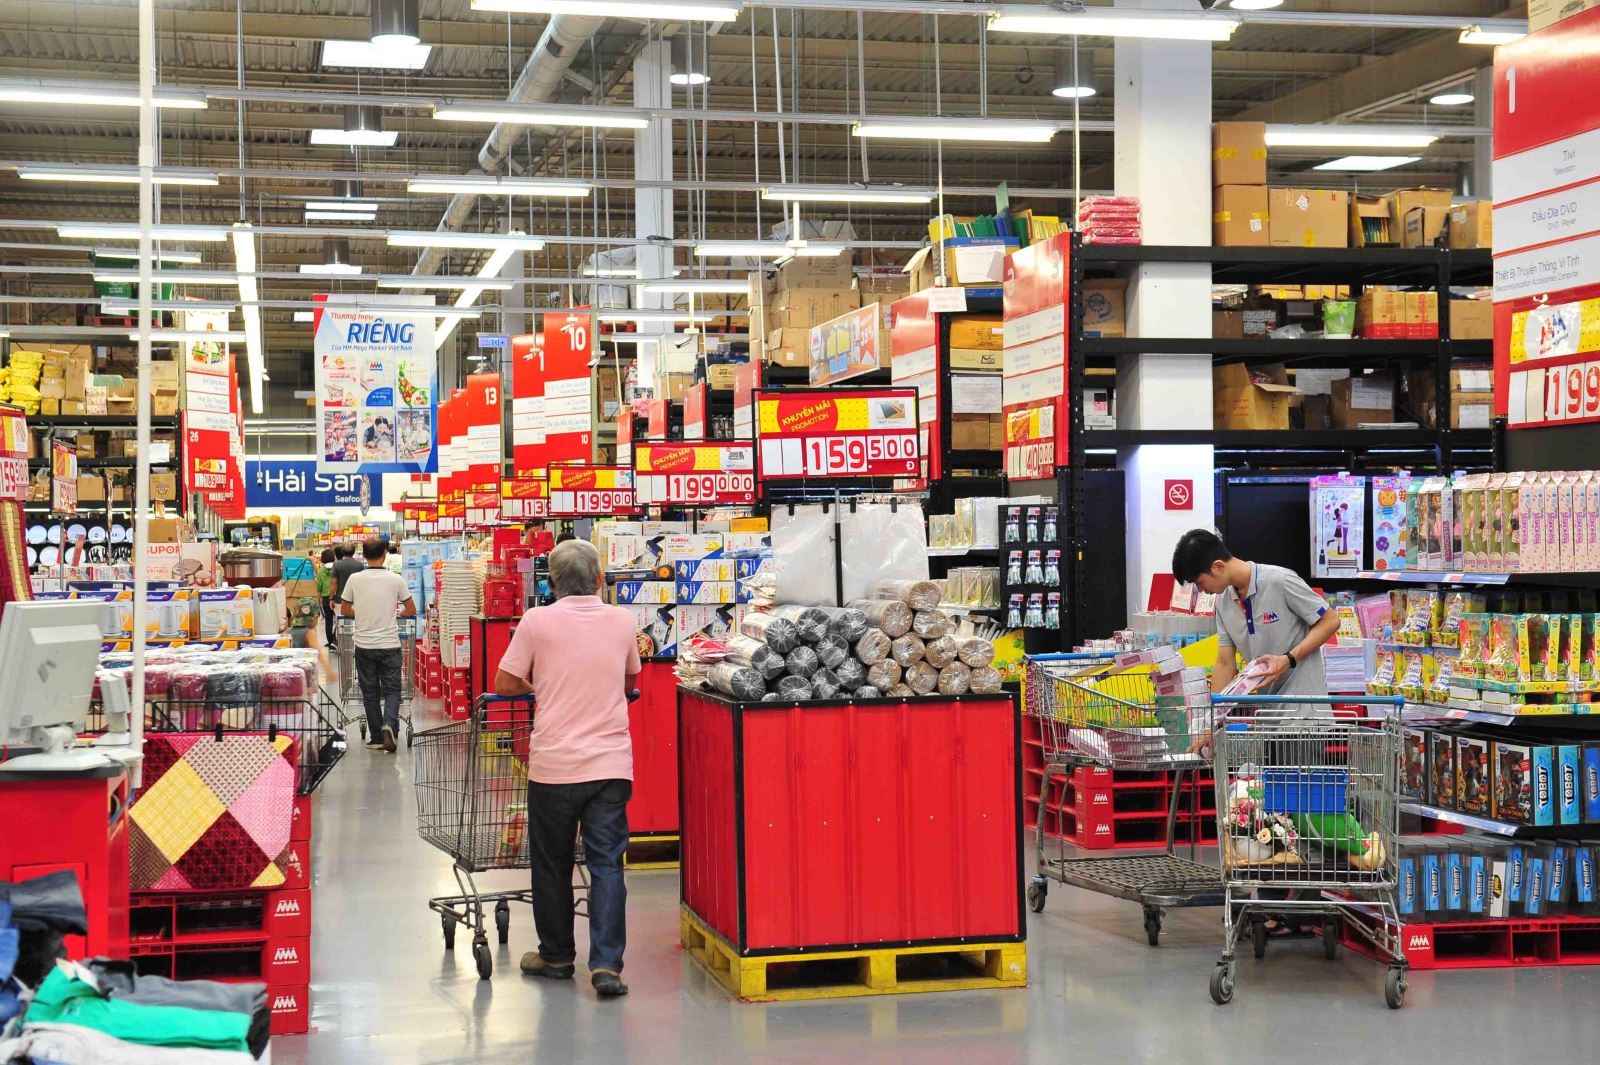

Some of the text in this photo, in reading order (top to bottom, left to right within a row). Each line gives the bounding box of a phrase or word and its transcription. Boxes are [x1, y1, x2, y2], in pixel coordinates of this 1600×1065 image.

[347, 318, 414, 344] RIÊNG
[569, 327, 586, 351] 10
[485, 388, 496, 404] 13
[782, 400, 831, 426] KHUYẾN MÃI
[791, 413, 829, 432] PROMOTION
[190, 431, 198, 442] 26
[581, 434, 588, 444] 10
[266, 468, 306, 492] Hải
[1539, 766, 1548, 808] TOBOT
[1565, 764, 1574, 806] TOBOT
[1590, 767, 1598, 800] TOBOT
